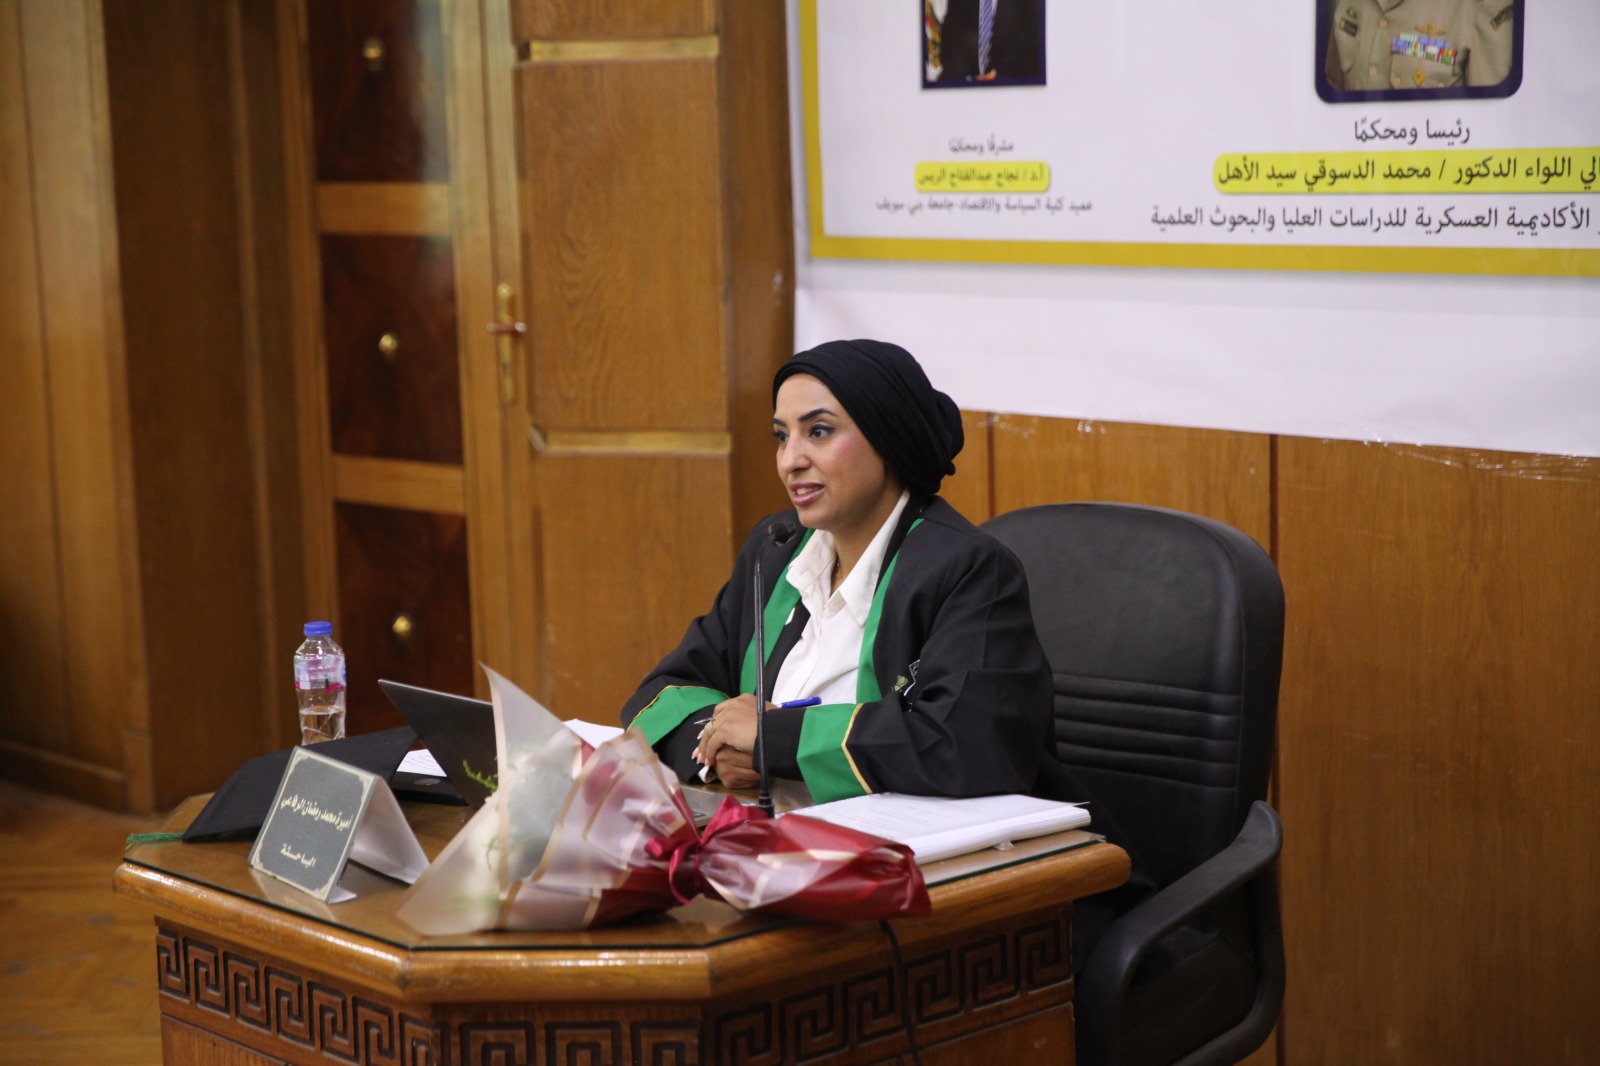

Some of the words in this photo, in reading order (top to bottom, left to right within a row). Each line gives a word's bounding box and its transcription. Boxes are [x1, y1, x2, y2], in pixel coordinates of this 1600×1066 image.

[1426, 118, 1470, 146] رئيسا
[1218, 154, 1260, 184] الأهل
[1266, 165, 1297, 187] سيد
[1304, 158, 1375, 192] الدسوقي
[1382, 162, 1432, 179] محمد
[1438, 158, 1446, 179] /
[1453, 156, 1517, 186] الدكتور
[1525, 156, 1572, 184] اللواء
[1151, 204, 1203, 233] العلمية
[1210, 206, 1276, 233] والبحوث
[1282, 206, 1322, 234] العليا
[1330, 206, 1407, 232] للدراسات
[1415, 206, 1498, 235] العسكرية
[1506, 200, 1590, 236] الأكاديمية
